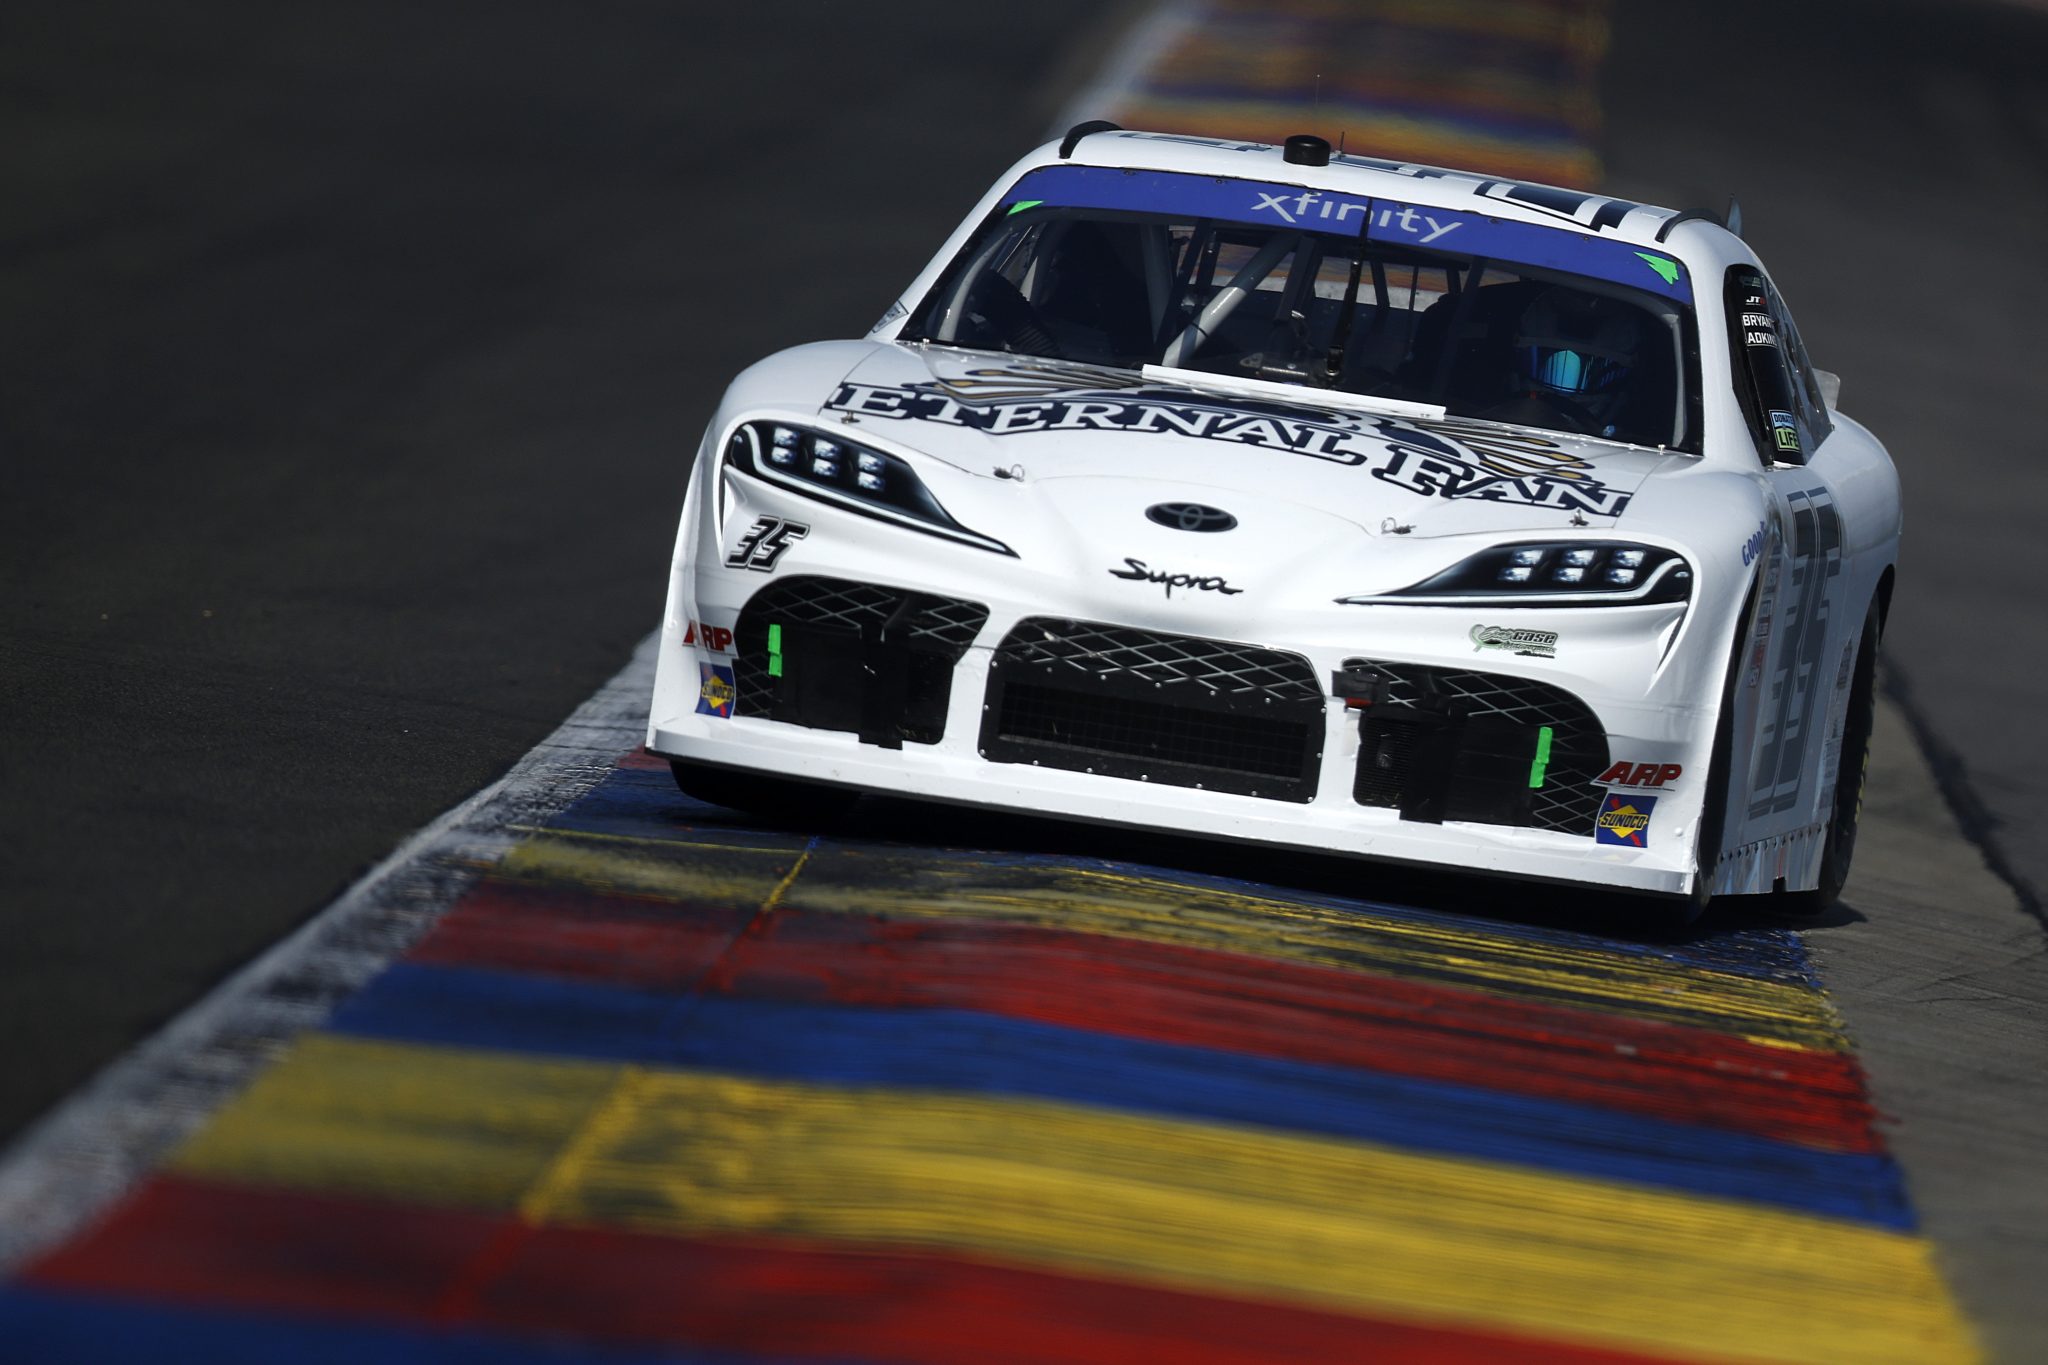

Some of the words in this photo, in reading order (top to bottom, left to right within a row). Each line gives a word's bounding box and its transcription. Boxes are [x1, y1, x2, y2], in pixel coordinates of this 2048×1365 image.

[1251, 191, 1463, 244] xfinity
[823, 382, 1368, 466] ETERNAL
[1371, 443, 1634, 518] FAN
[1778, 431, 1799, 448] LIFE
[724, 514, 811, 573] 35
[1108, 557, 1244, 599] Supra
[682, 620, 733, 652] ARP
[702, 681, 734, 700] SUNOCO
[1597, 761, 1682, 787] ARP
[1600, 813, 1646, 829] SUNOCO
